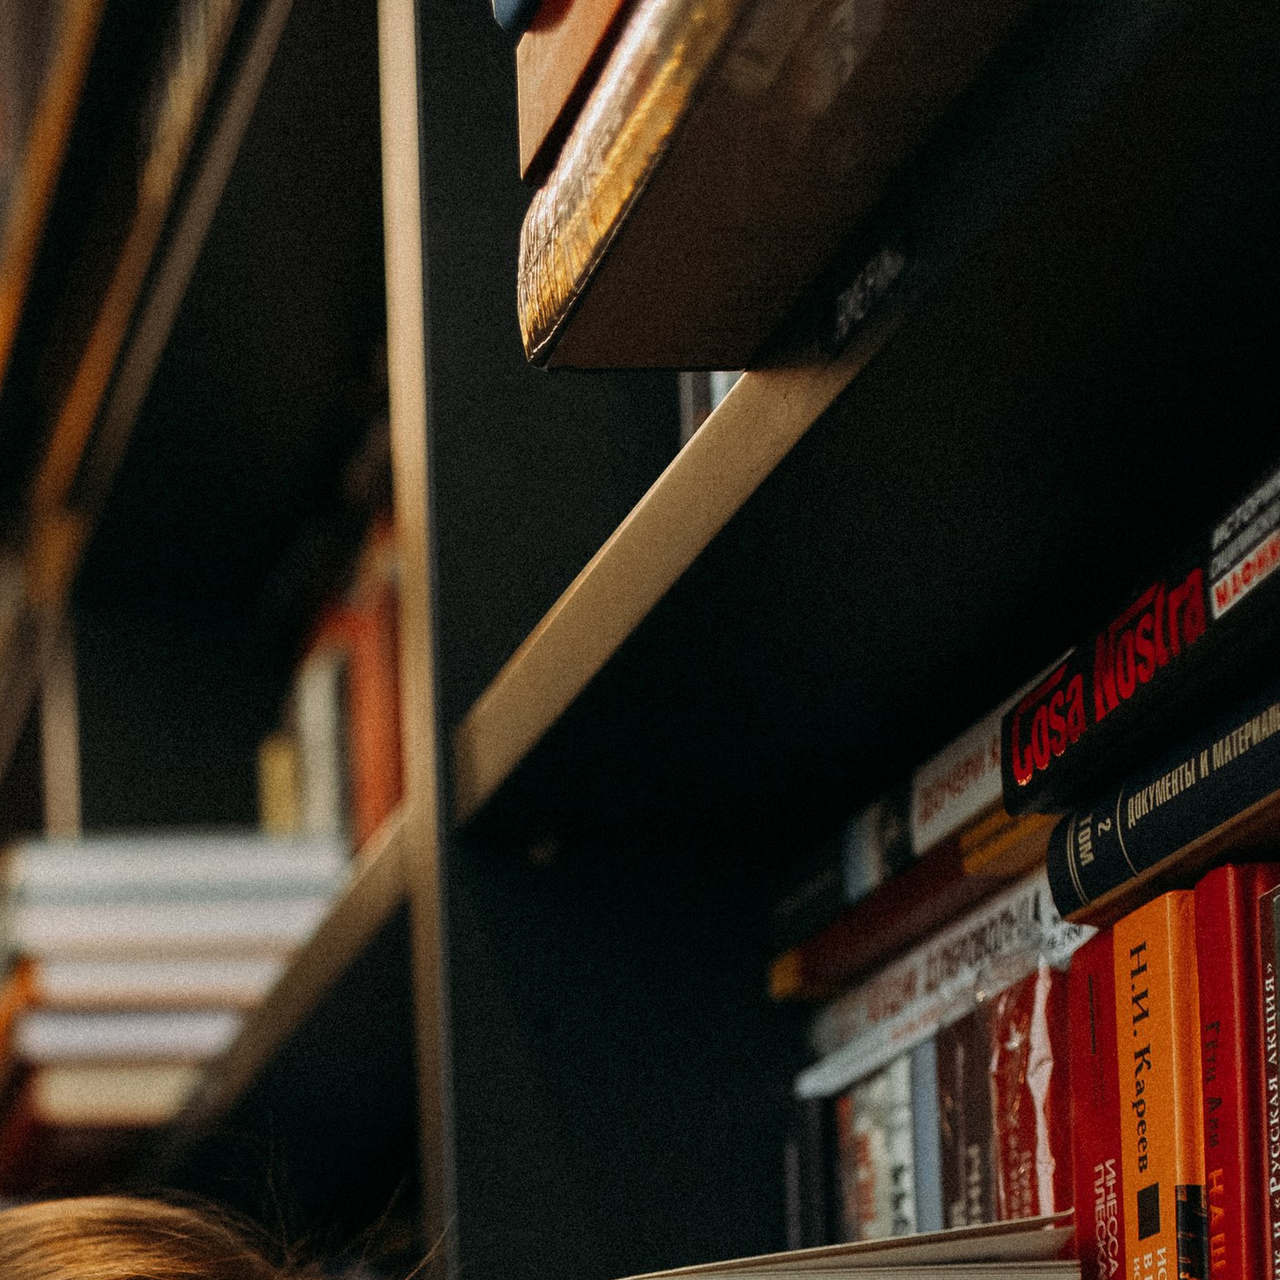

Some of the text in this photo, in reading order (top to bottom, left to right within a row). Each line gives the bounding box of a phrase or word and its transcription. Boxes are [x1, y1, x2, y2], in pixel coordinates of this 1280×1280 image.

[1012, 663, 1087, 786] Cosa
[1094, 568, 1206, 722] Nostra
[1097, 818, 1113, 837] 2
[1127, 757, 1196, 829] ДОКУМЕНТЫ
[1200, 749, 1210, 778] И
[1077, 813, 1095, 867] ТОМ
[1130, 941, 1152, 1173] Н.И. Кареев
[1105, 1158, 1119, 1278] ИНЕССА
[1143, 1252, 1154, 1269] В
